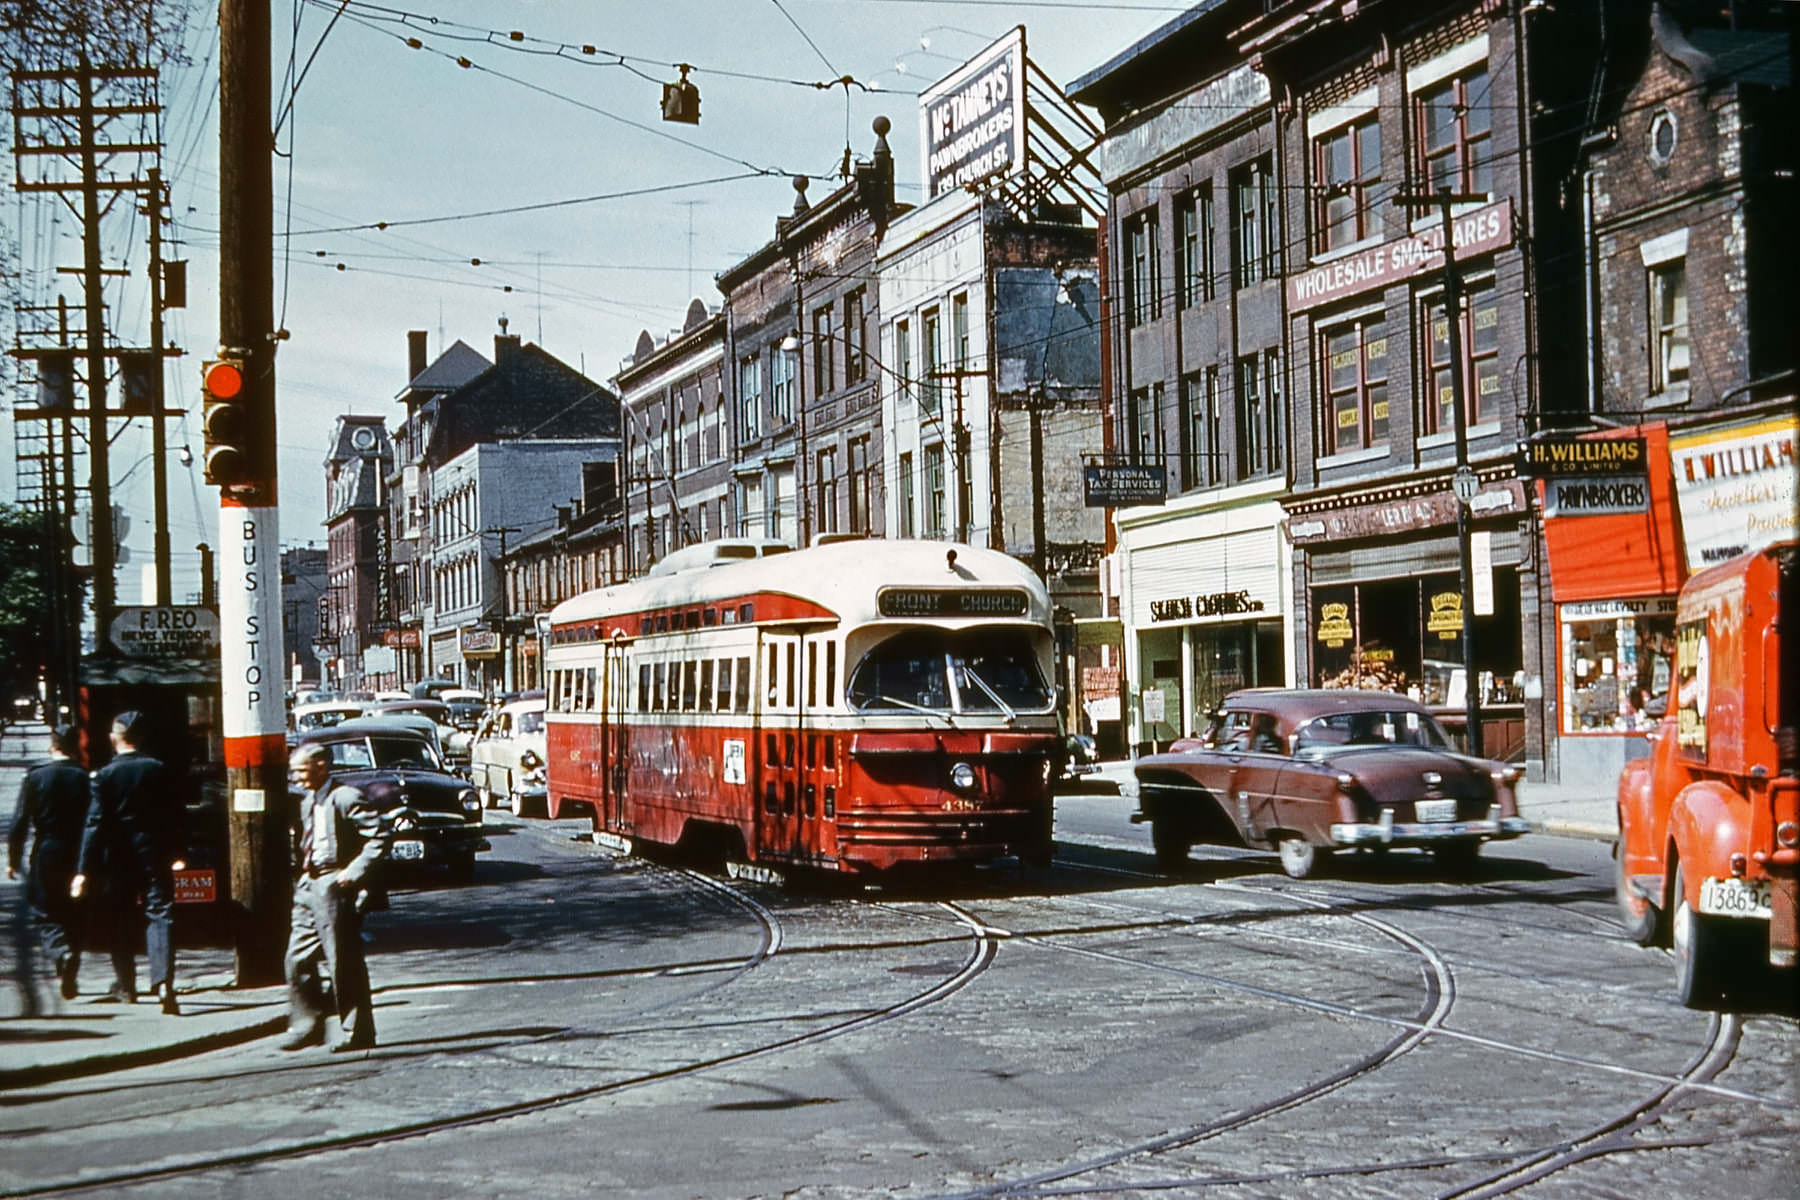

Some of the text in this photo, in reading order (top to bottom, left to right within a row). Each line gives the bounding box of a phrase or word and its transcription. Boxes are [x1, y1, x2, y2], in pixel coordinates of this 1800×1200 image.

[930, 107, 1012, 176] PAWNBROKERS
[1295, 210, 1500, 300] WHOLESALE SMALLARES
[1088, 478, 1161, 489] TAX SERVICES
[1099, 468, 1151, 479] PERSONAL
[1557, 484, 1645, 509] PAWNBROKERS
[243, 521, 257, 591] BUS
[885, 593, 1021, 611] FRONT CHURCH
[162, 630, 211, 641] VENDOR
[246, 616, 261, 710] STOP
